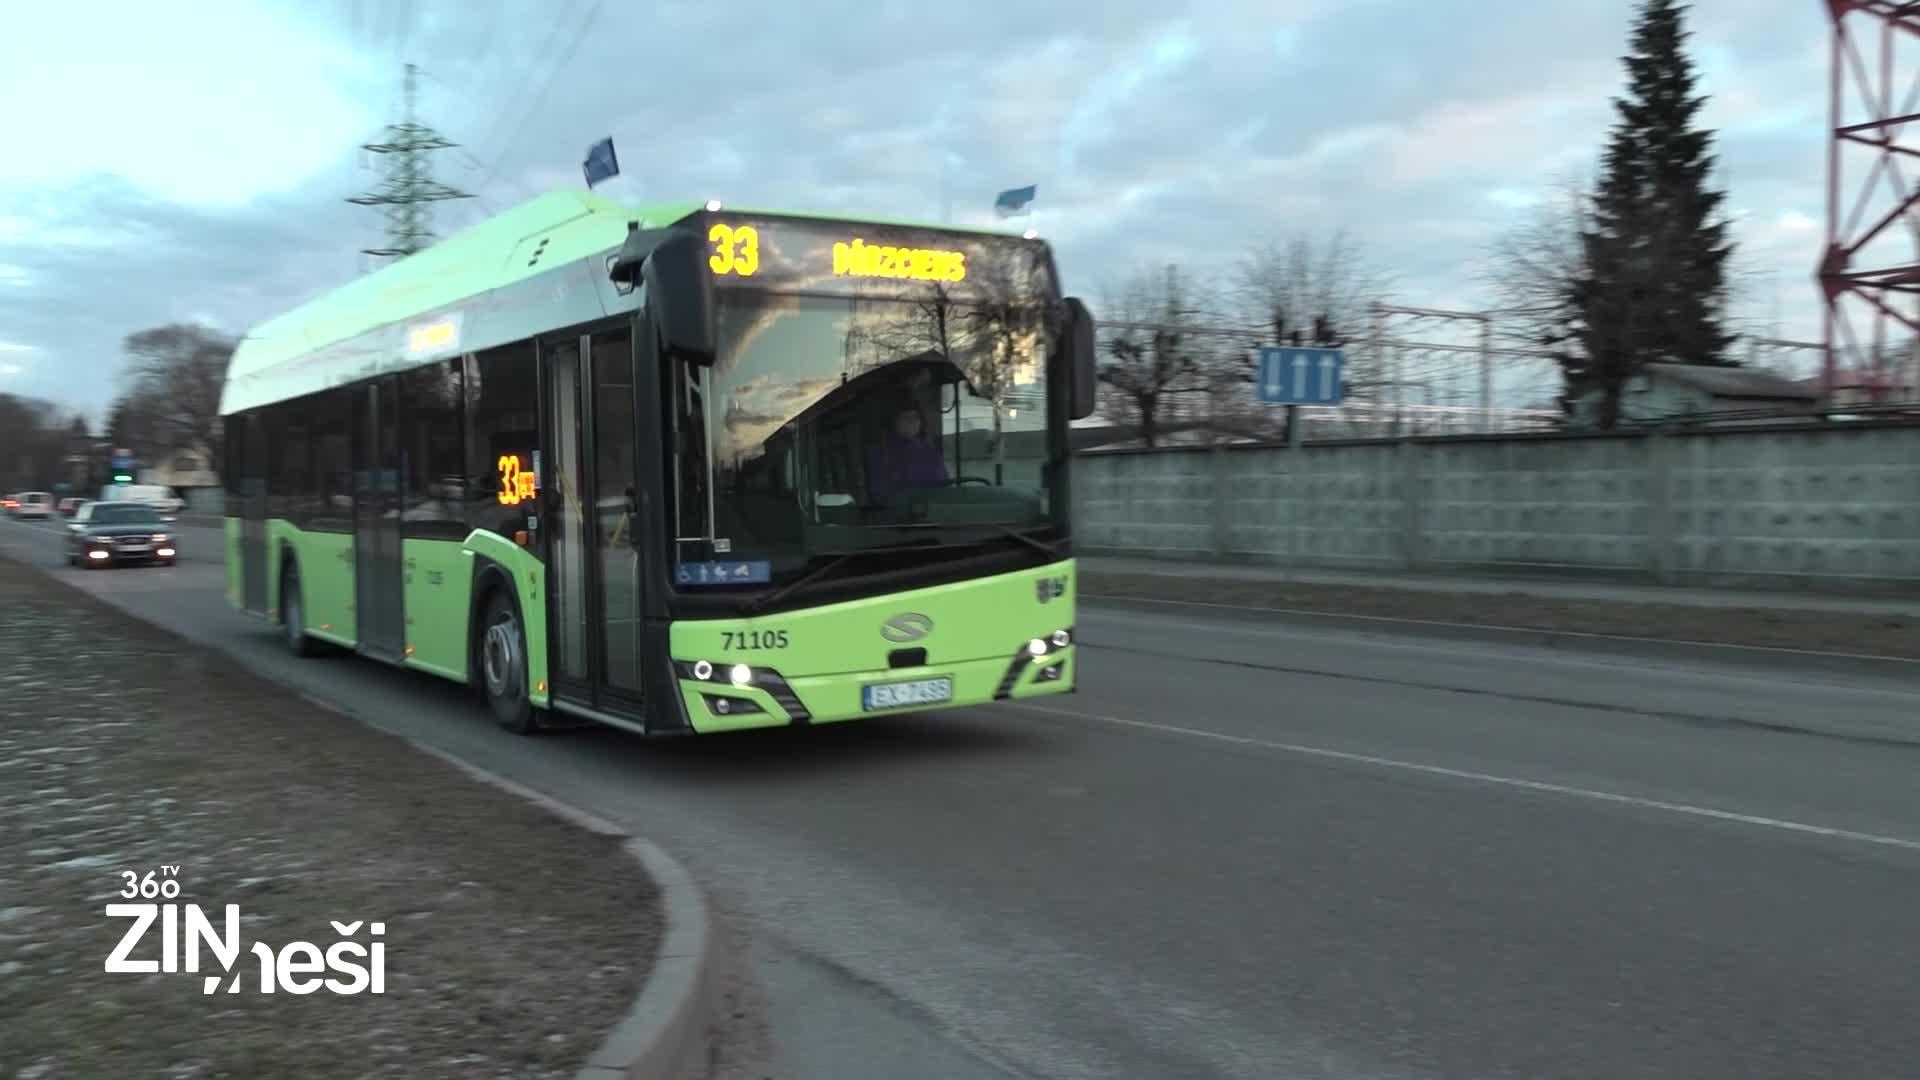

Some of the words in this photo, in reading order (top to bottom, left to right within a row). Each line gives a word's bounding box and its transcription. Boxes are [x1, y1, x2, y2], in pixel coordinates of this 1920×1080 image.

[708, 224, 759, 276] 33
[498, 455, 520, 505] 33
[720, 629, 789, 652] 71105
